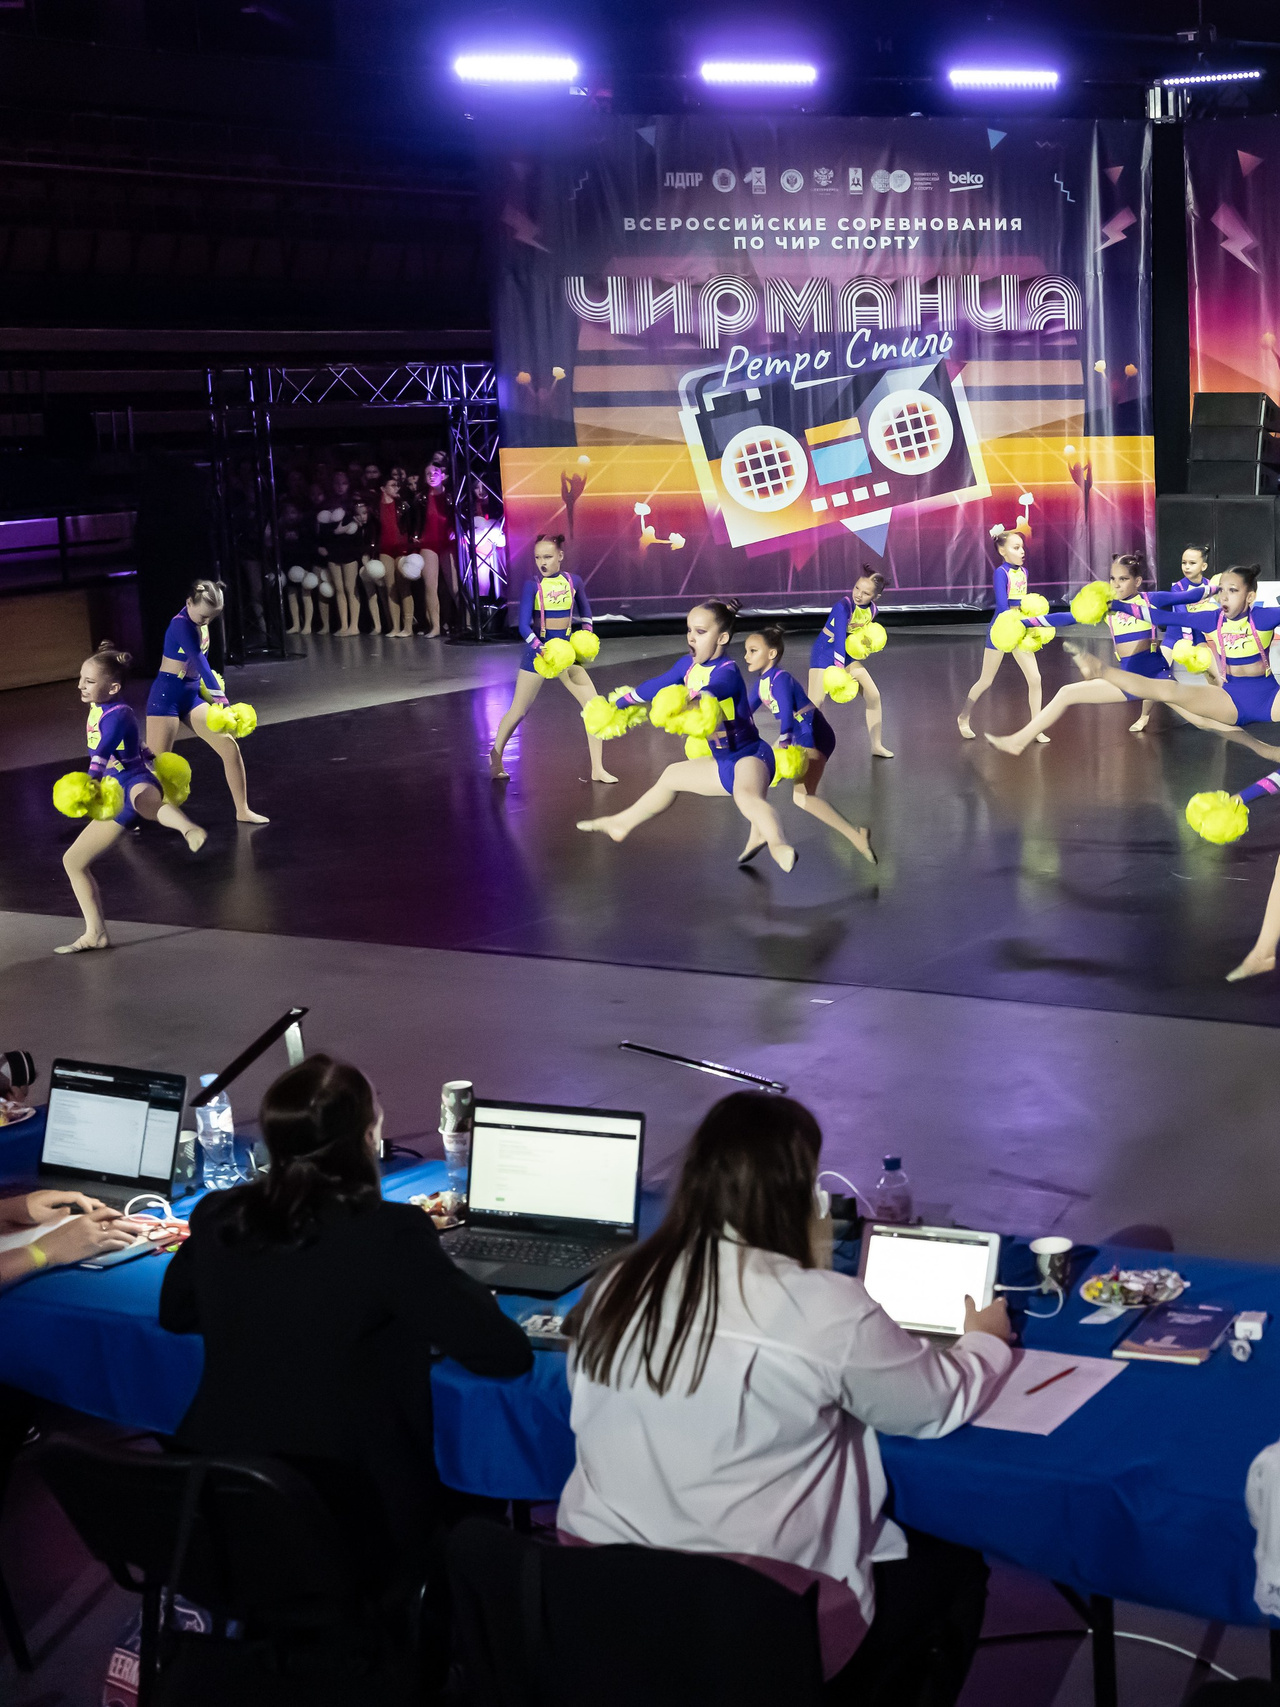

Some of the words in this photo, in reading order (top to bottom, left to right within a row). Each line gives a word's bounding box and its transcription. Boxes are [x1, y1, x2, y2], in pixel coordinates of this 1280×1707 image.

[663, 171, 704, 190] ЛДПР
[948, 170, 985, 185] beko
[623, 214, 827, 231] ВСЕРОССИЙСКИЕ
[837, 217, 1022, 231] СОРЕВНОВАНИЯ
[733, 236, 765, 250] ПО
[775, 236, 821, 250] ЧИР
[831, 236, 920, 250] СПОРТУ
[722, 345, 831, 388] Ретро
[845, 327, 954, 369] Стиль
